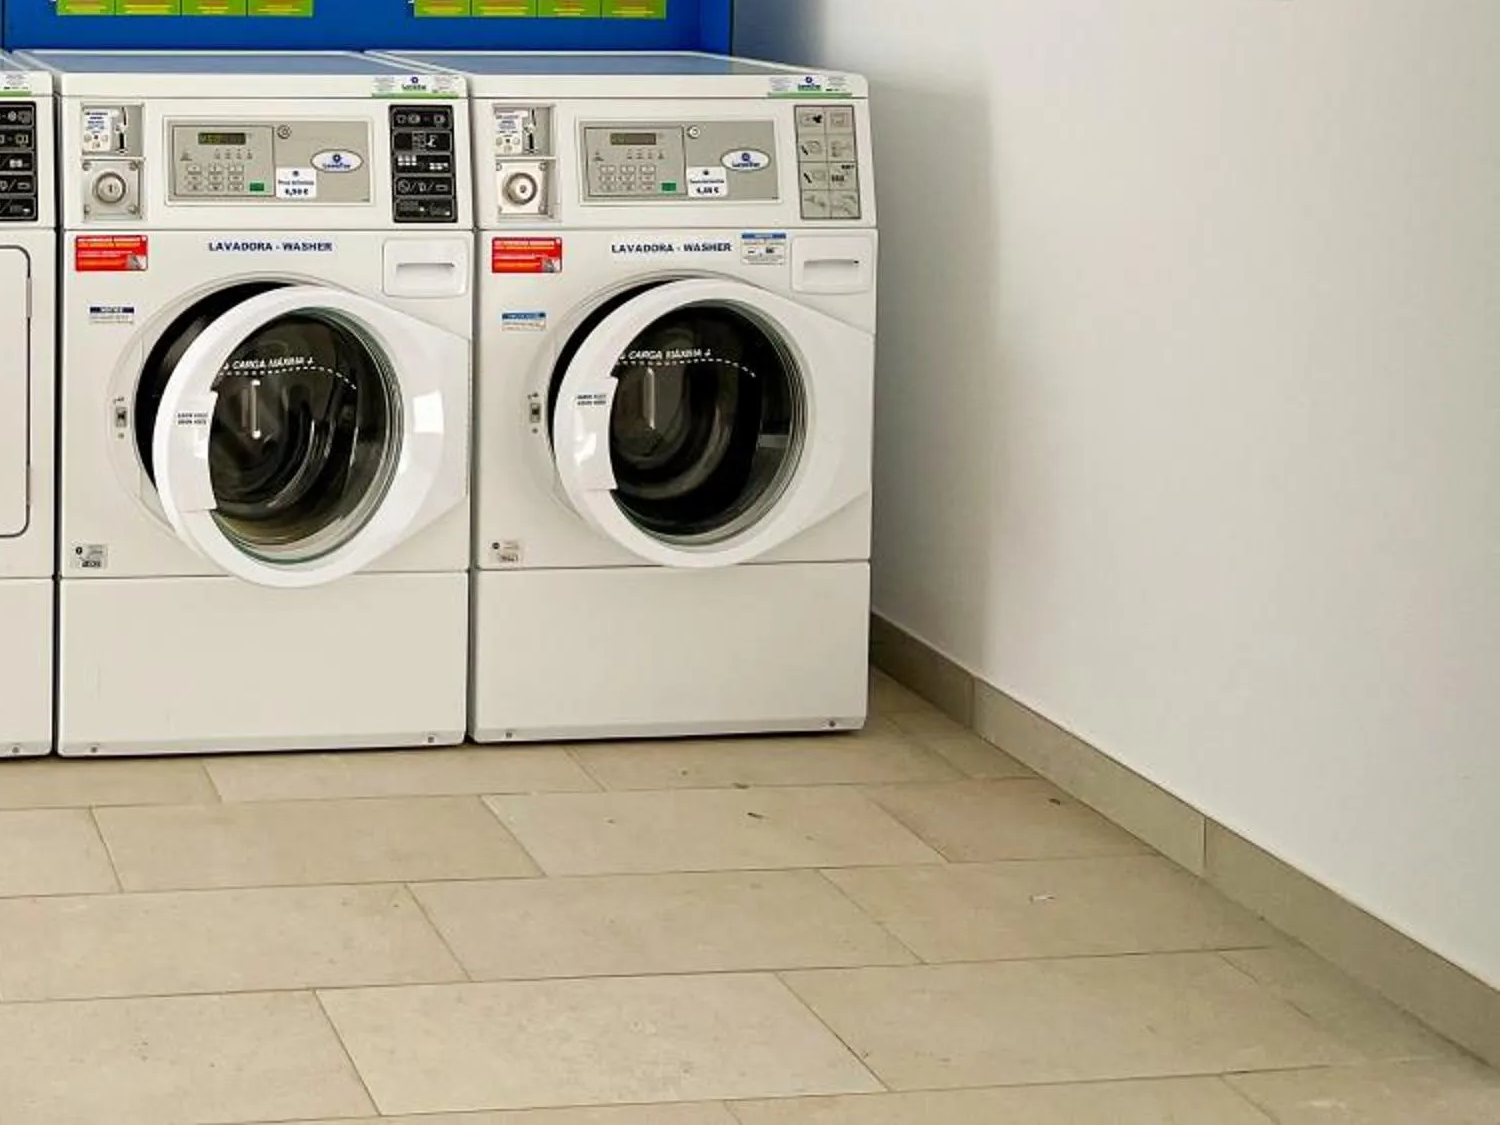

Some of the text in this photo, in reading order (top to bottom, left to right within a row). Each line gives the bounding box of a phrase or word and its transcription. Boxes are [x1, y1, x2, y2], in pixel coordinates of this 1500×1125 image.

[208, 242, 273, 252] LAVADORA
[282, 242, 333, 252] WASHER
[611, 243, 675, 254] LAVADORA
[683, 242, 733, 253] WASHER
